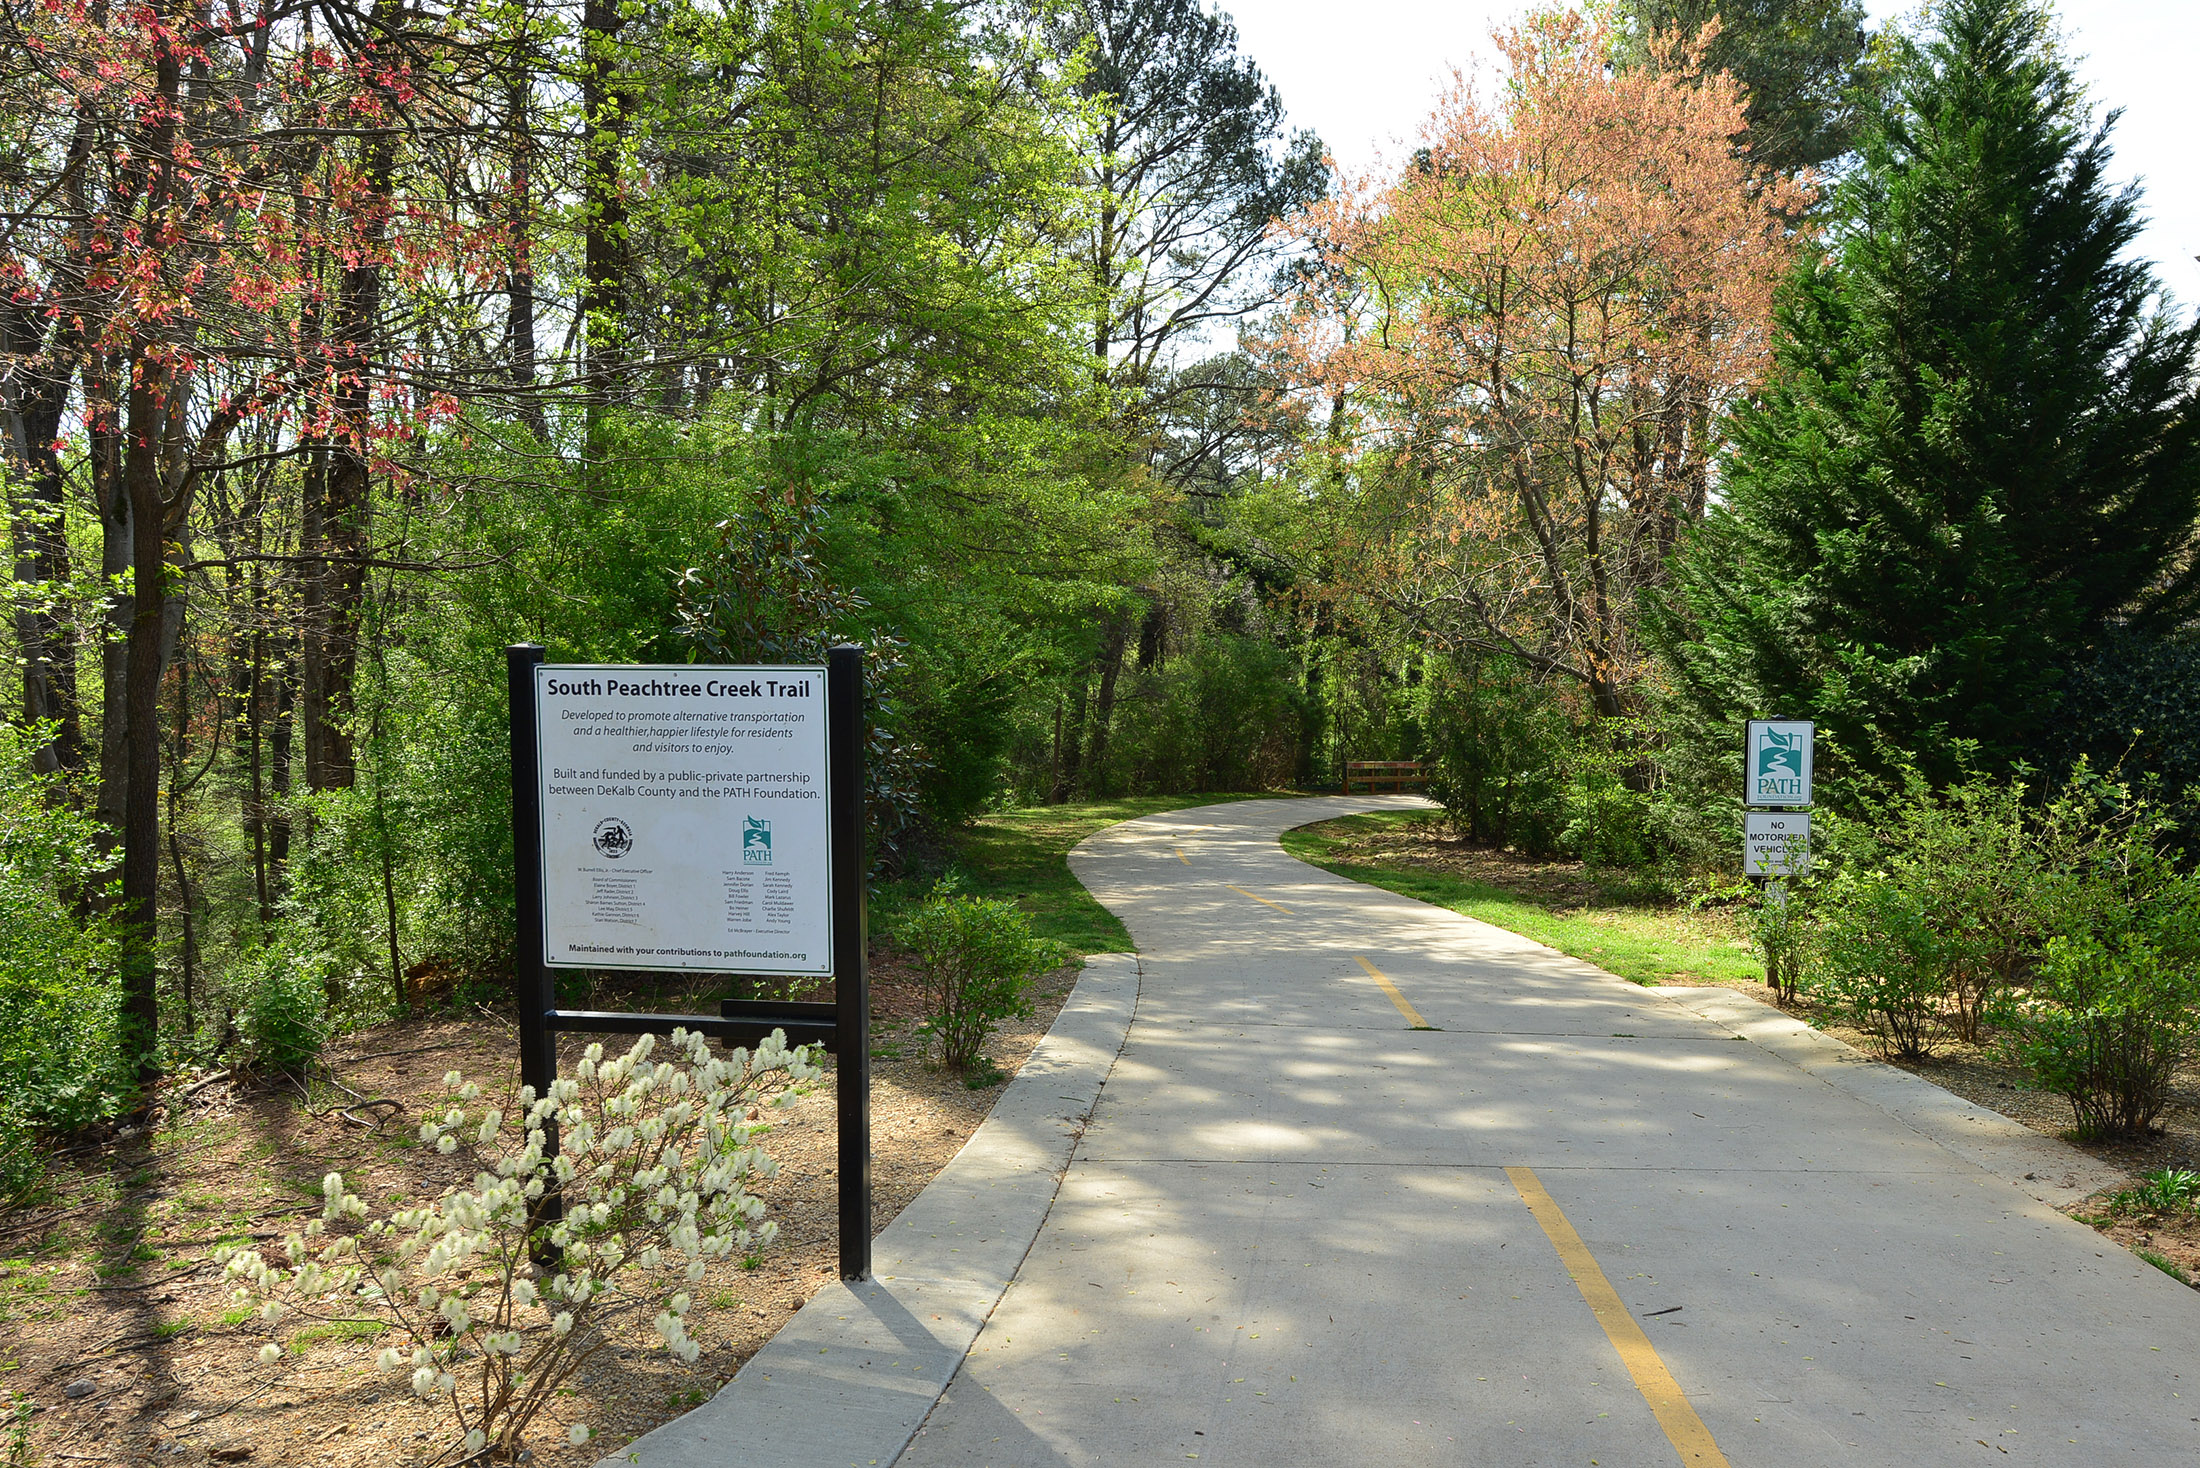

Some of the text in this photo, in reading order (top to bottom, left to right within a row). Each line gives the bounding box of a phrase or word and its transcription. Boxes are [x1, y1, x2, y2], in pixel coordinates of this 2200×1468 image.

[548, 679, 810, 698] South Peachtree Creek Trail
[562, 710, 804, 724] Developed to promote alternative transportation
[573, 726, 592, 736] and
[690, 727, 728, 739] lifestyle
[731, 727, 745, 738] for
[747, 728, 793, 738] residents
[632, 742, 734, 755] and visitors to enjoy.
[554, 768, 810, 784] Built and funded by a public-private partnership
[549, 785, 820, 799] between DeKalb County and the PATH Foundation.
[1758, 778, 1801, 794] PATH
[744, 850, 772, 861] PATH
[569, 944, 614, 954] Maintained
[616, 945, 634, 954] with
[636, 948, 654, 957] your
[656, 947, 711, 956] contributions
[724, 949, 806, 961] pathfoundation.org
